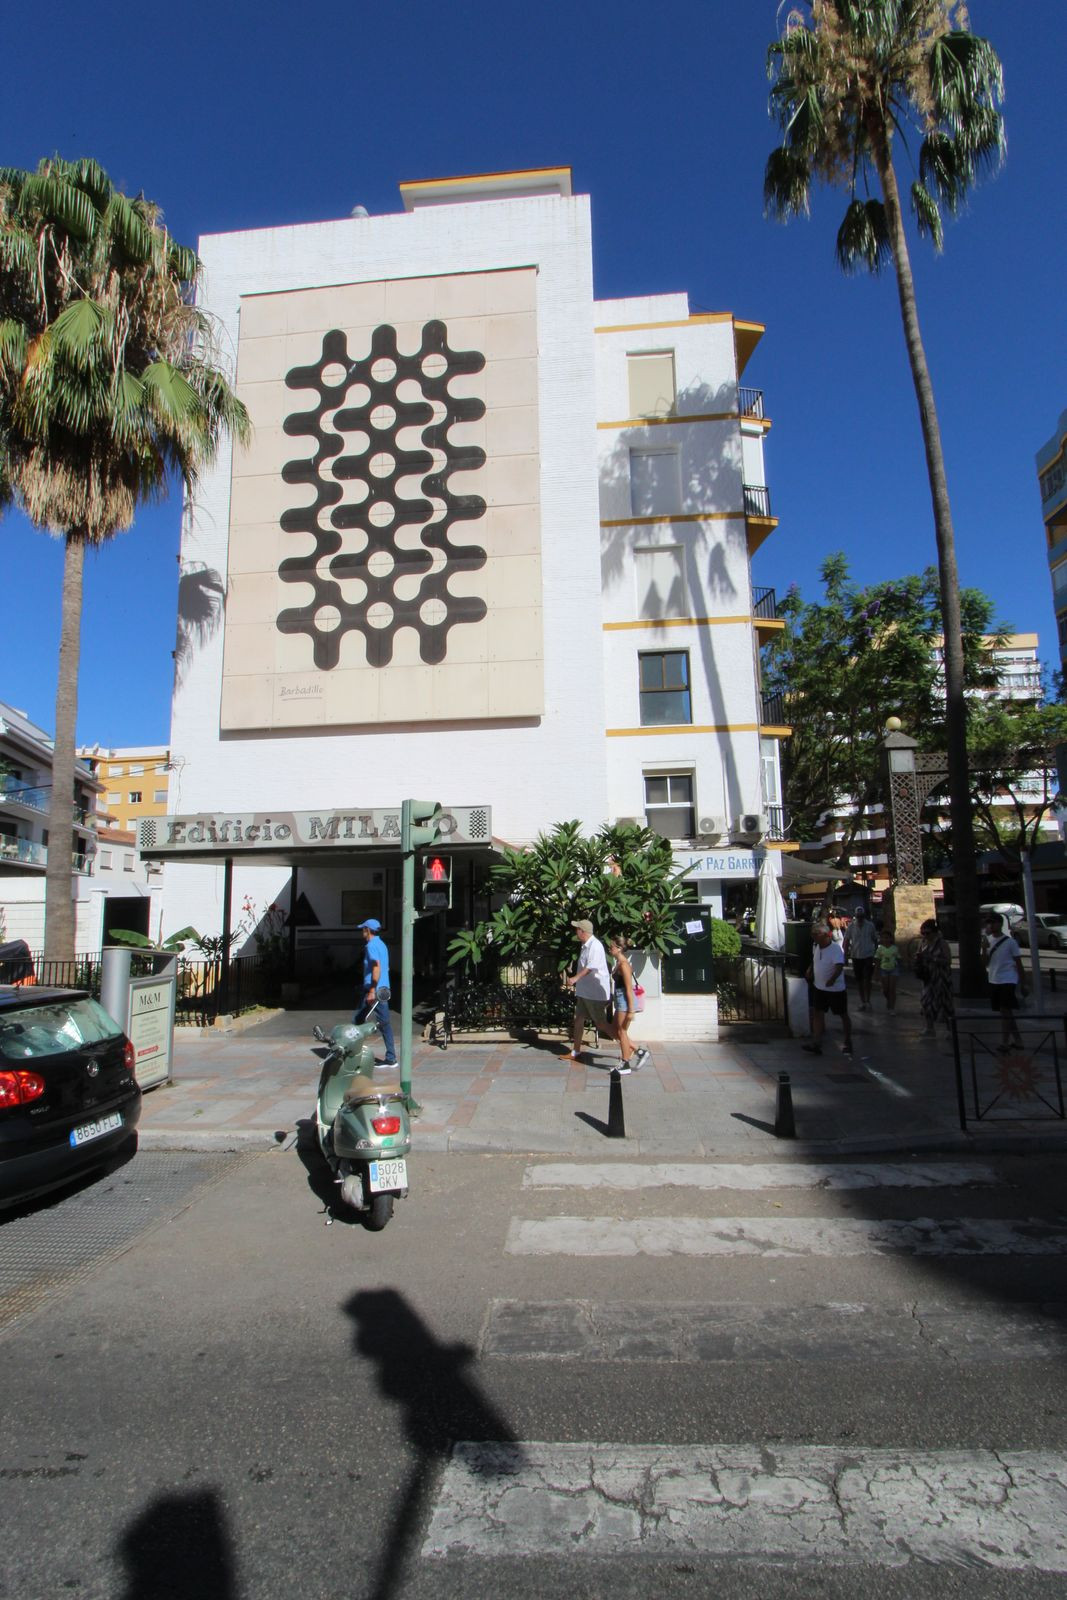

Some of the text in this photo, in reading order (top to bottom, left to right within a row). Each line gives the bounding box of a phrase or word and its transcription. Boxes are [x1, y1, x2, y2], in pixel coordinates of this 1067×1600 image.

[167, 814, 458, 843] Edificio MILAO
[140, 992, 161, 1006] M&M
[378, 1162, 404, 1175] 5028
[379, 1175, 398, 1189] GKV
